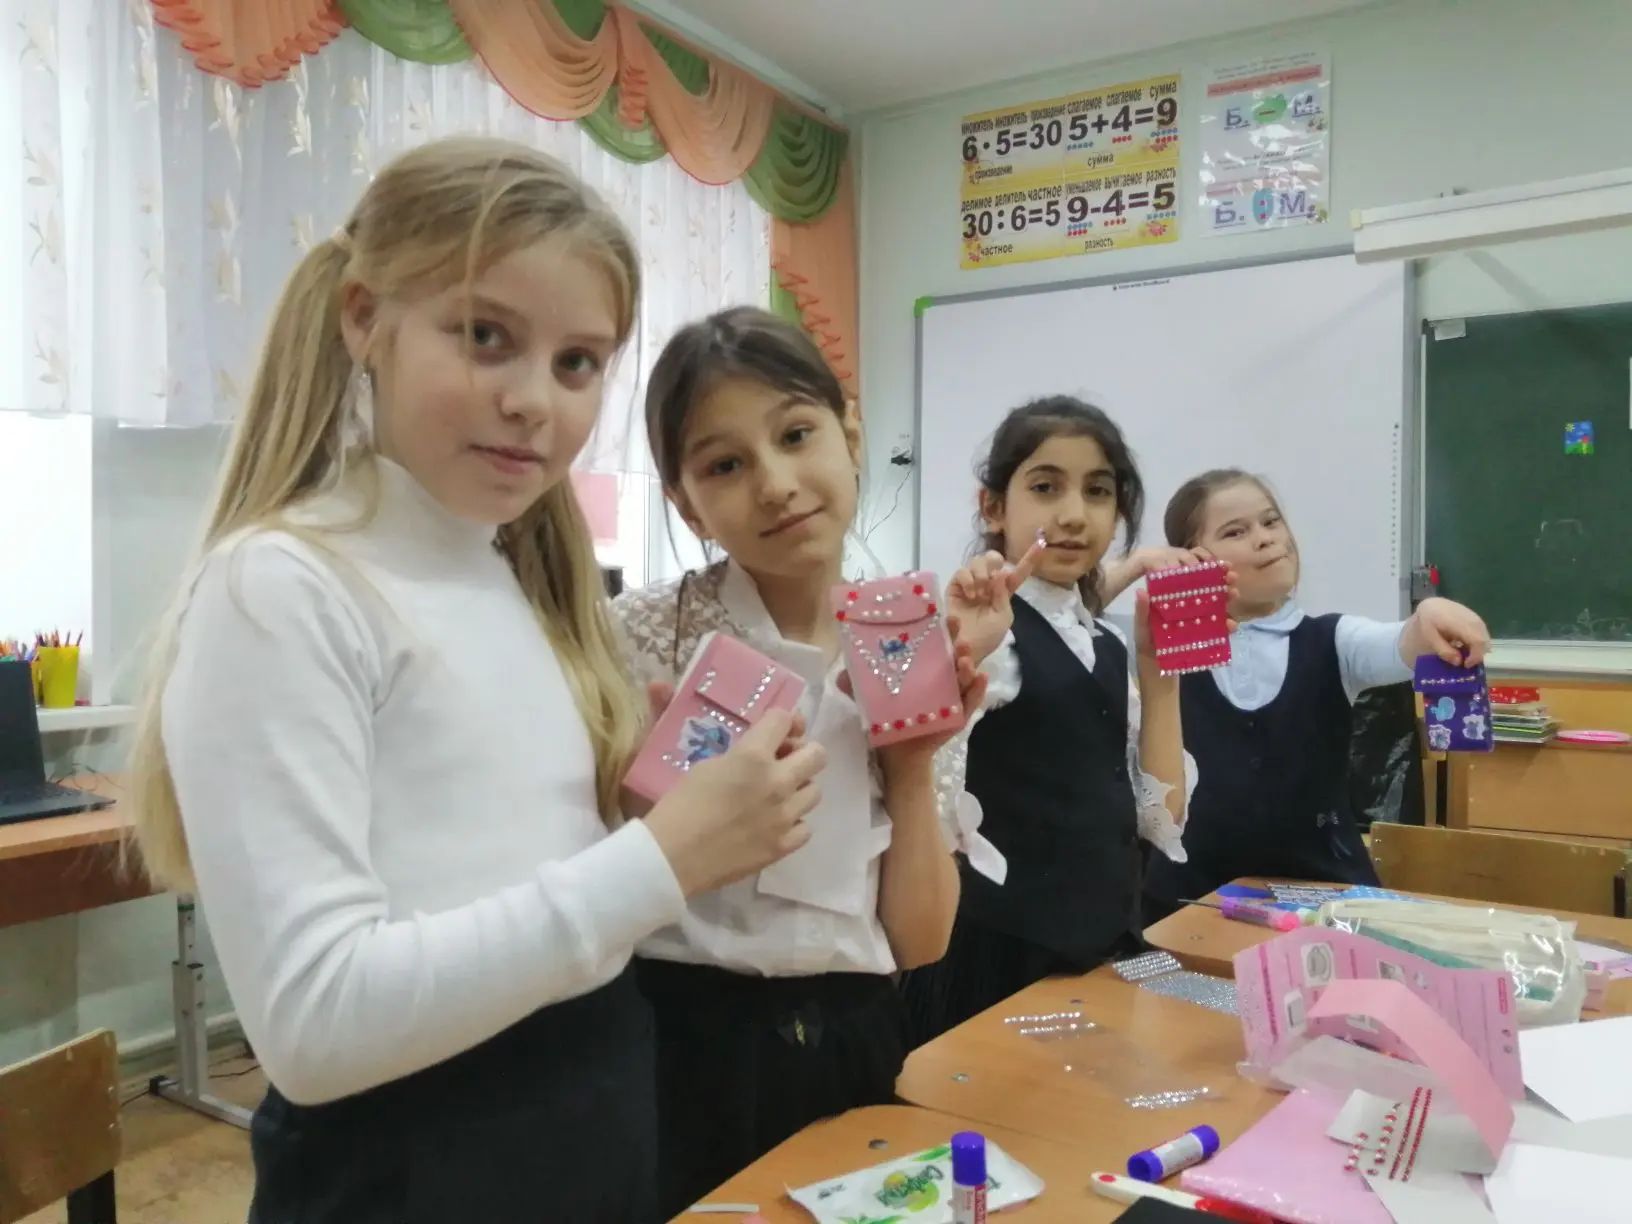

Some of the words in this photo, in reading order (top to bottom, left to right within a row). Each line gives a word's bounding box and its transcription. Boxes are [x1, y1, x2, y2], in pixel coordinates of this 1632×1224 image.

[1149, 82, 1177, 101] сумма
[1087, 153, 1114, 169] сумма
[1028, 185, 1062, 201] частное
[980, 243, 1013, 256] частное
[1084, 238, 1114, 253] разность
